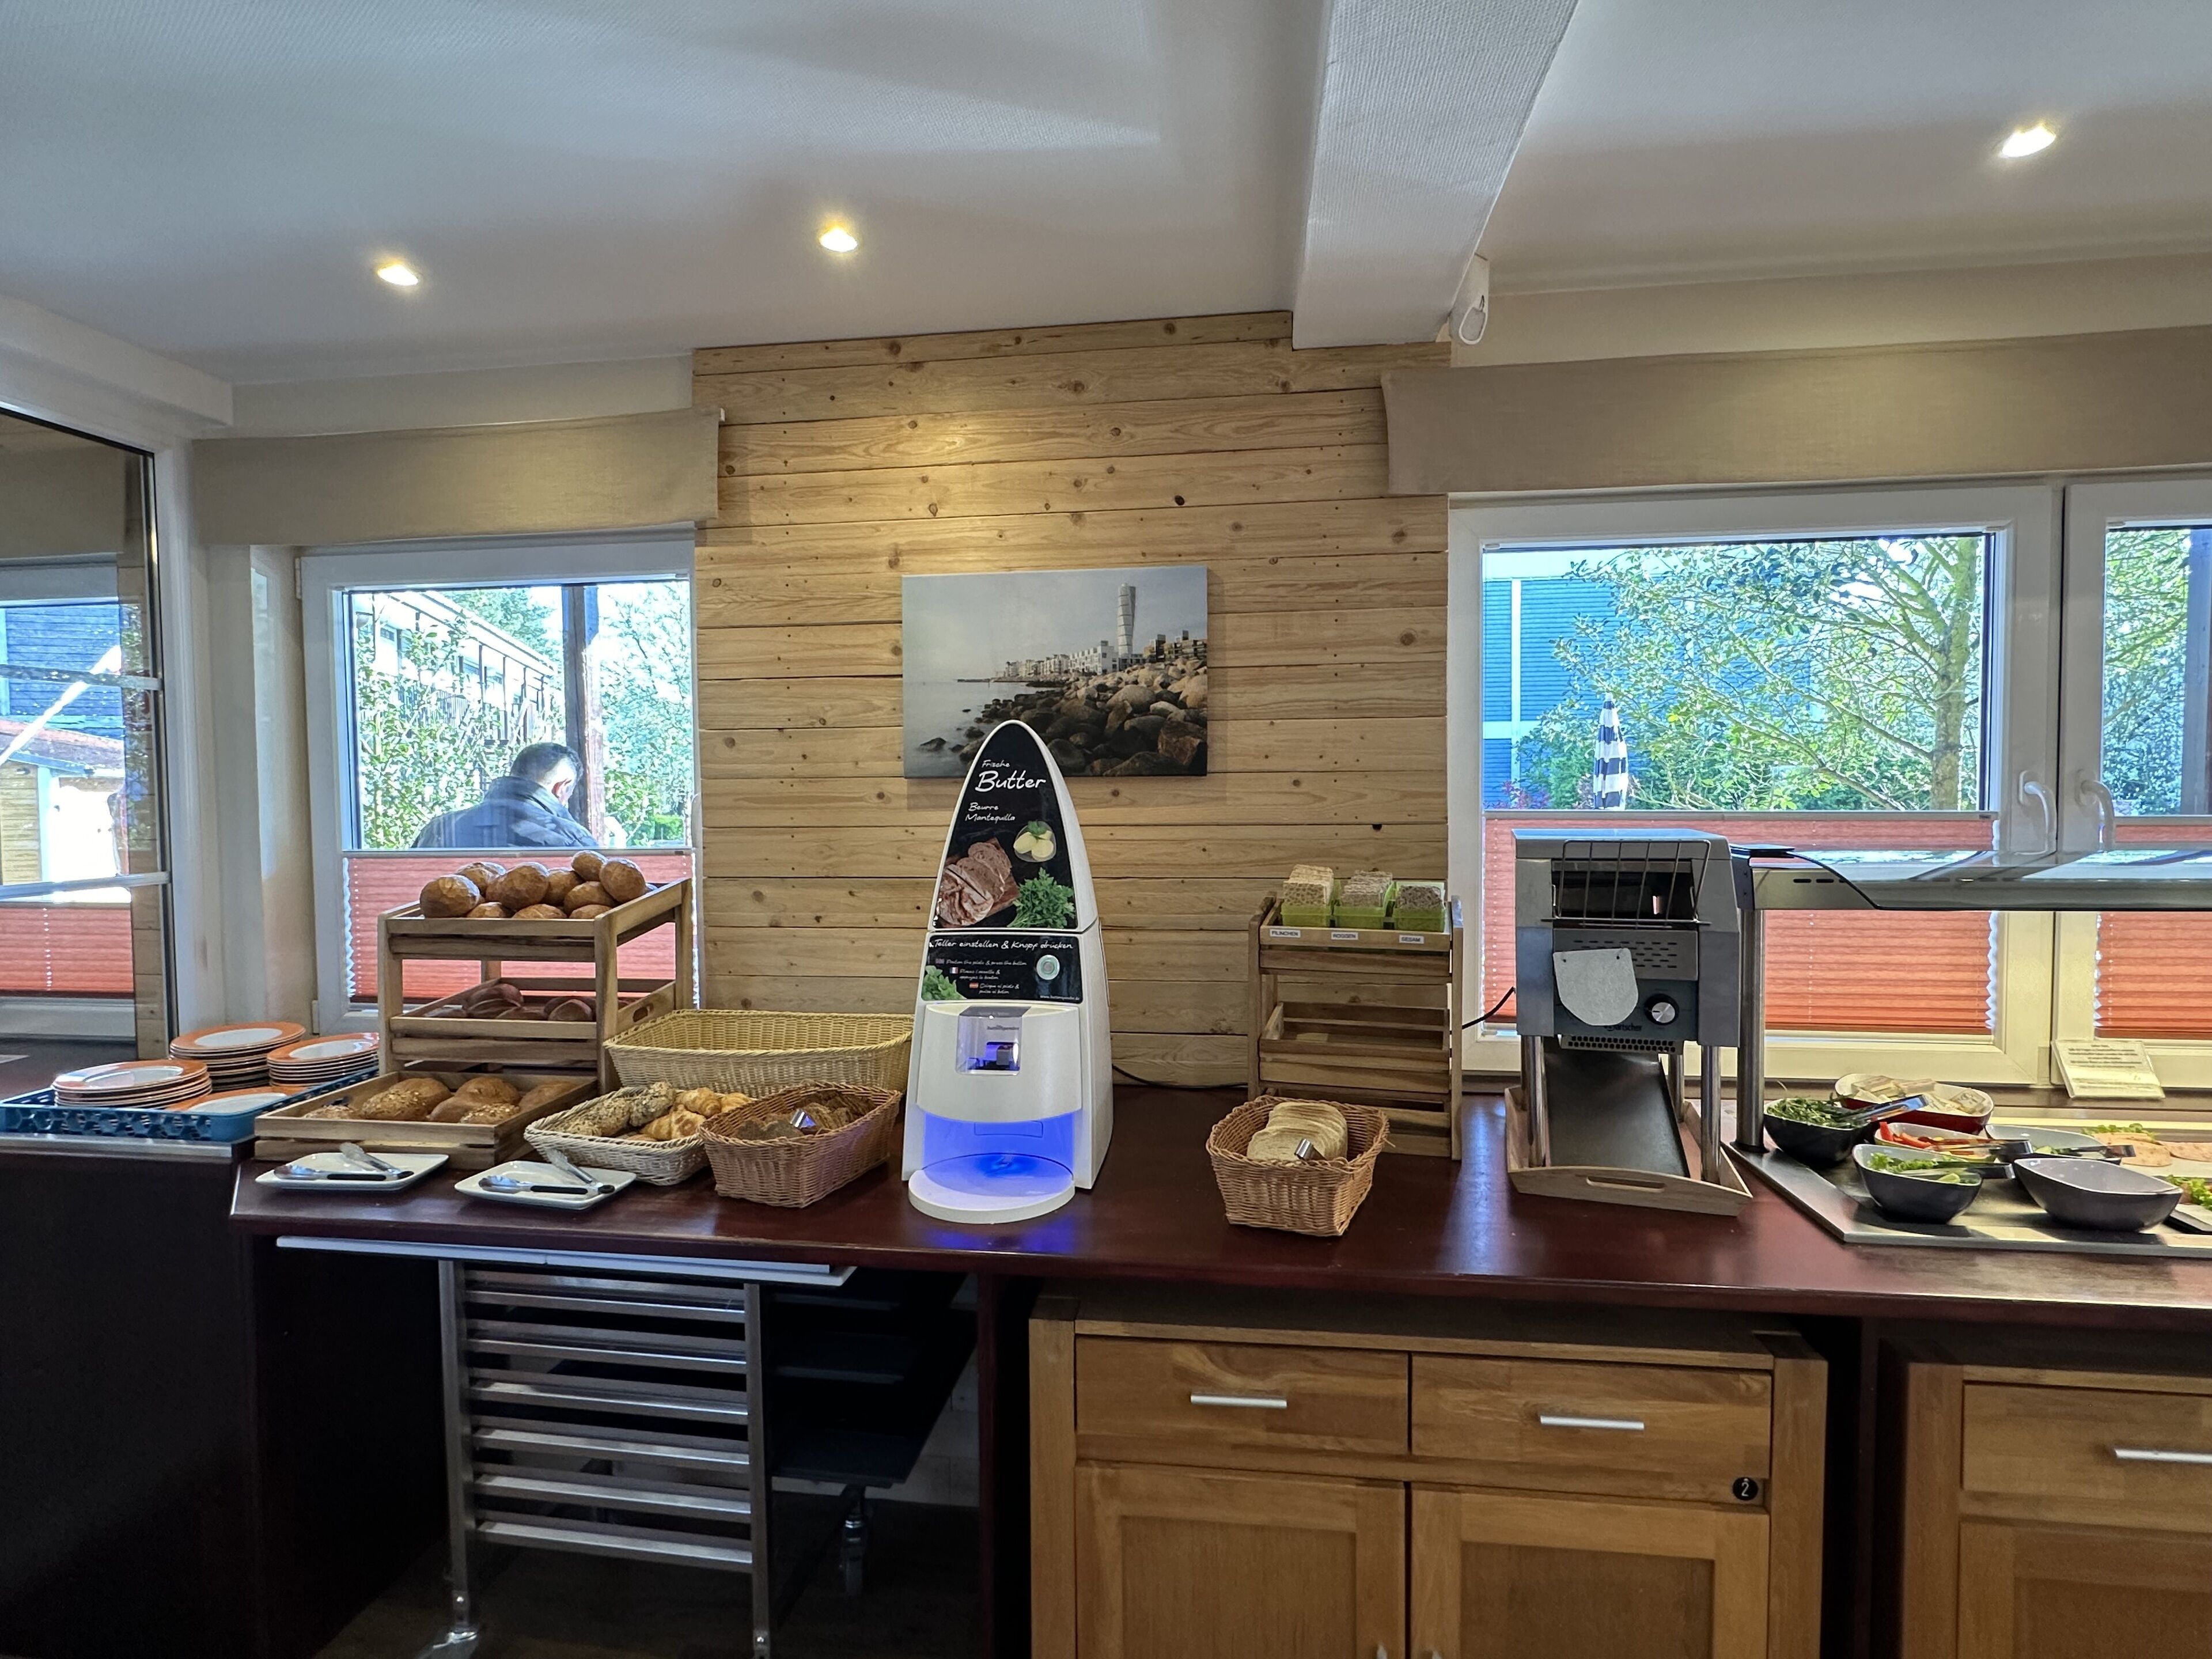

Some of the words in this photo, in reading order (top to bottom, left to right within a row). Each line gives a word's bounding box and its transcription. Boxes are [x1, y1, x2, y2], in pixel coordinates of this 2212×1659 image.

[982, 759, 1010, 768] Frische
[975, 770, 1047, 793] Butter
[968, 802, 999, 812] Beurre
[964, 813, 1016, 824] Mantequilla
[934, 938, 957, 948] Teller
[959, 940, 999, 948] einstellen
[1001, 940, 1009, 949] &
[1010, 941, 1039, 951] Knopf
[1741, 1482, 1749, 1497] 2
